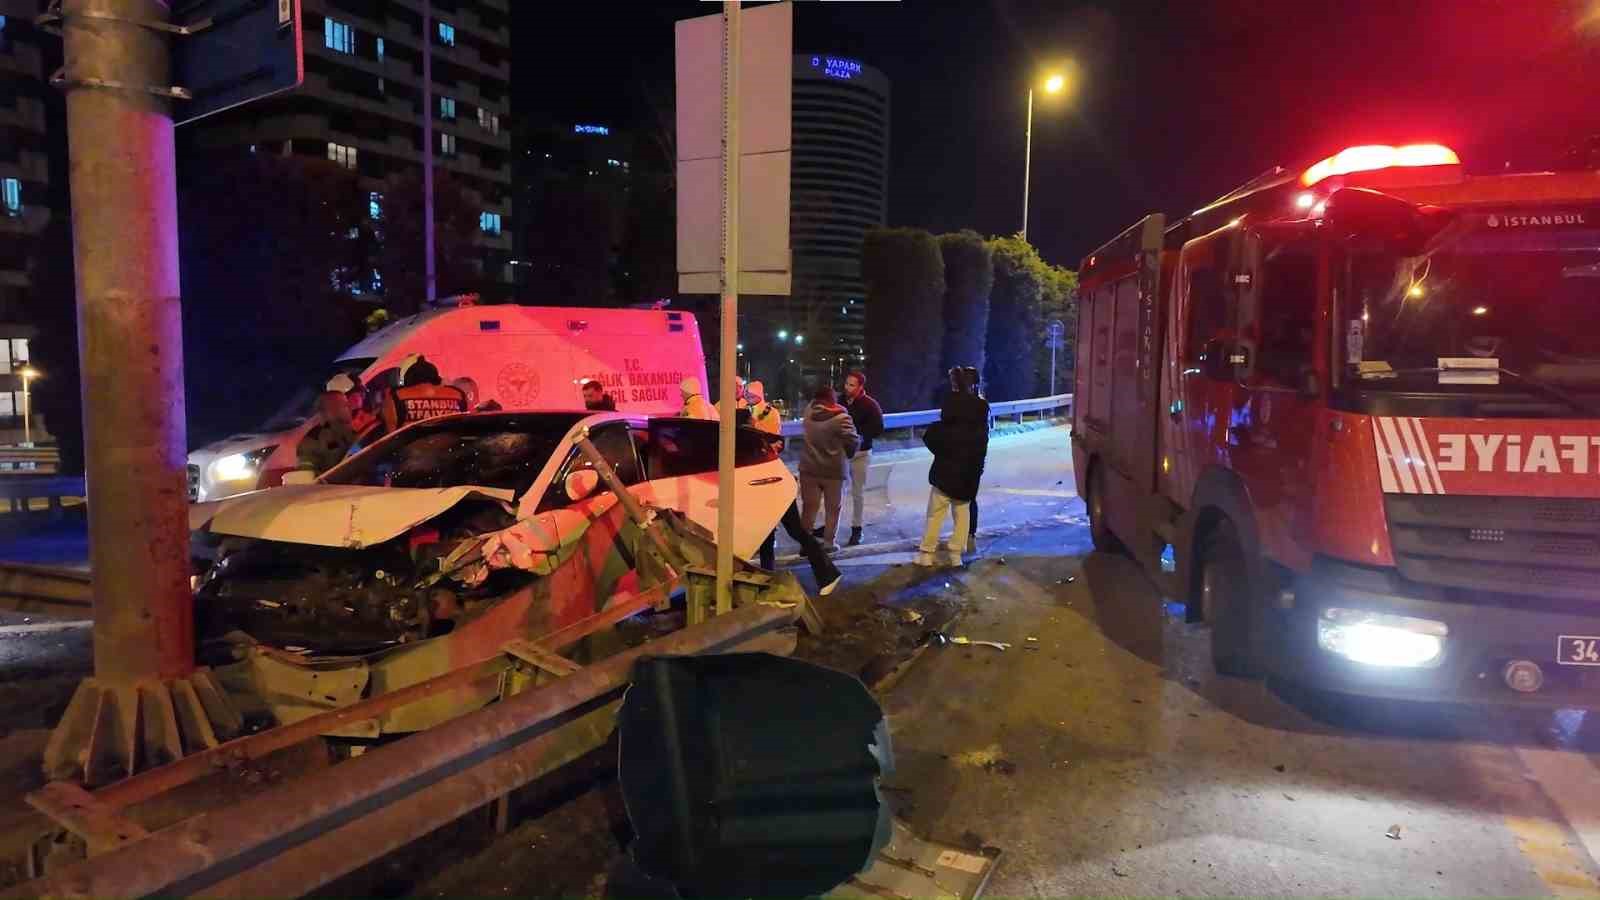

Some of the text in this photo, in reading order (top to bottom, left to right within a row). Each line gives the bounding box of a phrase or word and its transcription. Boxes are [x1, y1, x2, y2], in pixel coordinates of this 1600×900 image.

[824, 68, 850, 79] PLAZA
[623, 358, 643, 371] T.C.
[406, 400, 460, 410] STANBUL
[1571, 639, 1599, 662] 34
